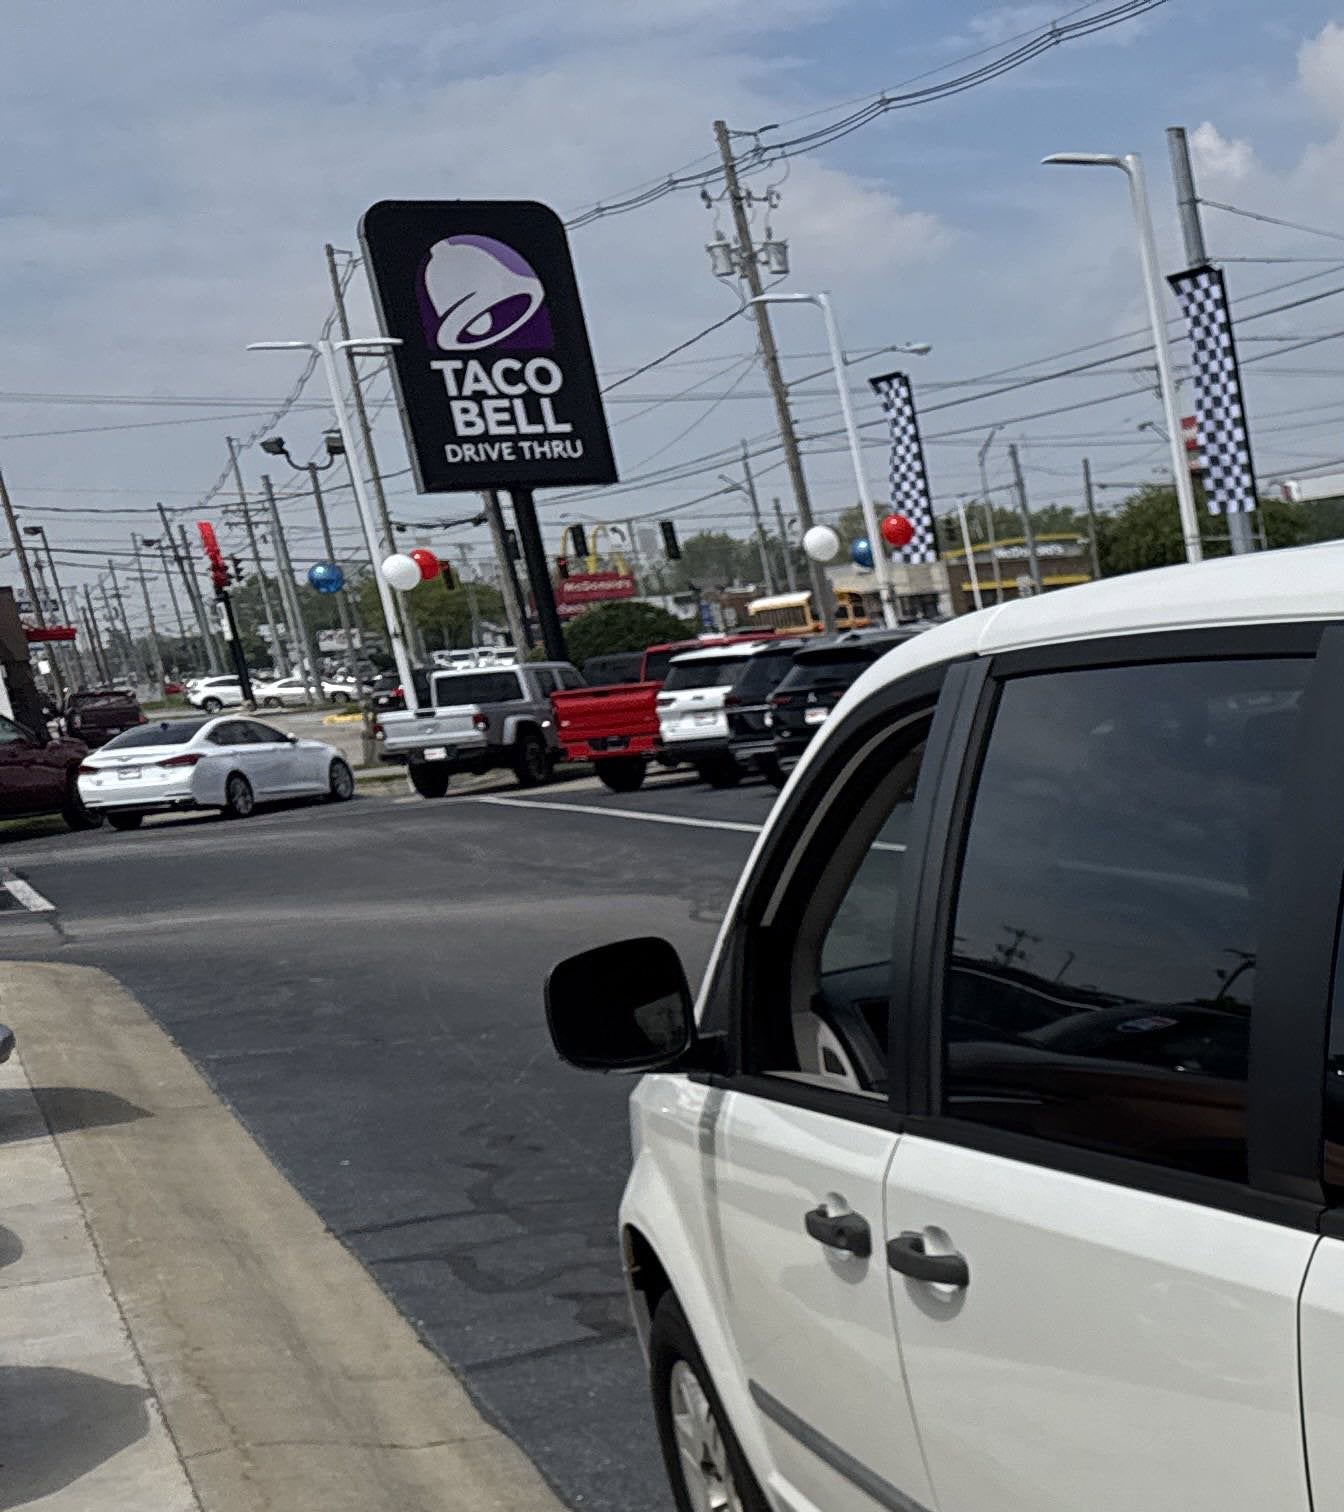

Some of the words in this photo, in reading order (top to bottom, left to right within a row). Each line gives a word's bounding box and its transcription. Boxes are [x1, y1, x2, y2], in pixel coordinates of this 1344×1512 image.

[430, 357, 564, 397] TACO
[450, 397, 573, 436] BELL
[444, 441, 517, 463] DRIVE
[517, 439, 584, 461] THRU
